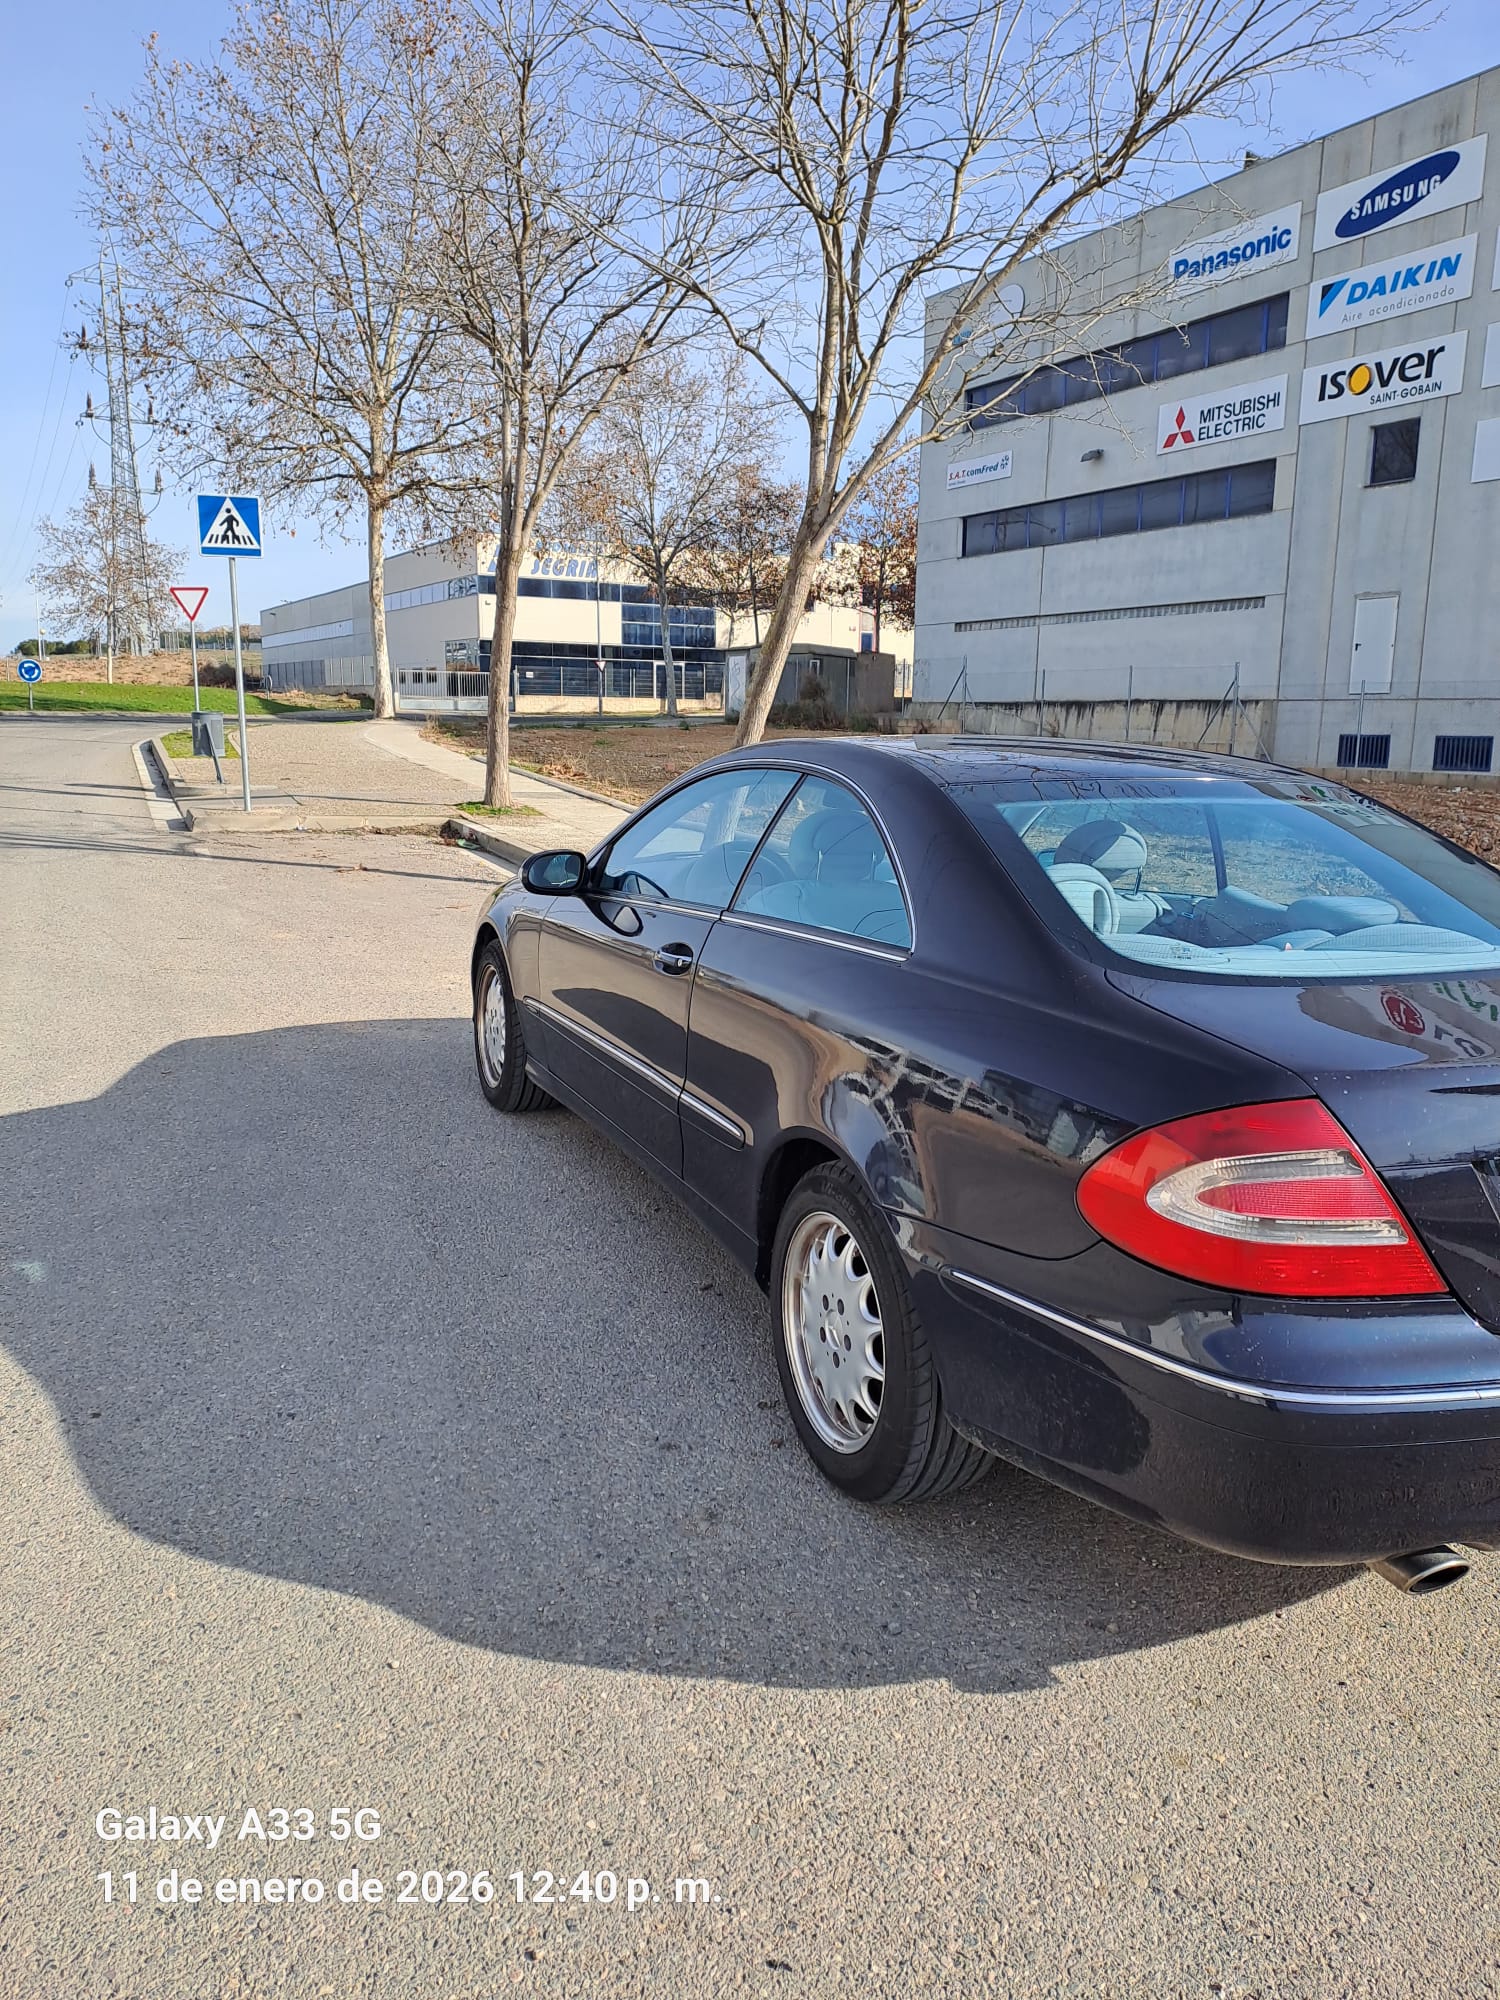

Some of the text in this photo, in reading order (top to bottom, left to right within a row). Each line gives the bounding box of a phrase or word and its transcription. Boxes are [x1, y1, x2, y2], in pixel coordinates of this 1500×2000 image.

[1350, 174, 1442, 220] SAMSUNG
[1174, 226, 1292, 279] Panasonic
[1346, 252, 1463, 305] DAIKIN
[1341, 285, 1455, 324] Aire acondicionado
[1199, 391, 1281, 424] MITSUBISHI
[1370, 381, 1442, 405] SAINT-GOBAIN
[1198, 413, 1266, 441] ELECTRIC
